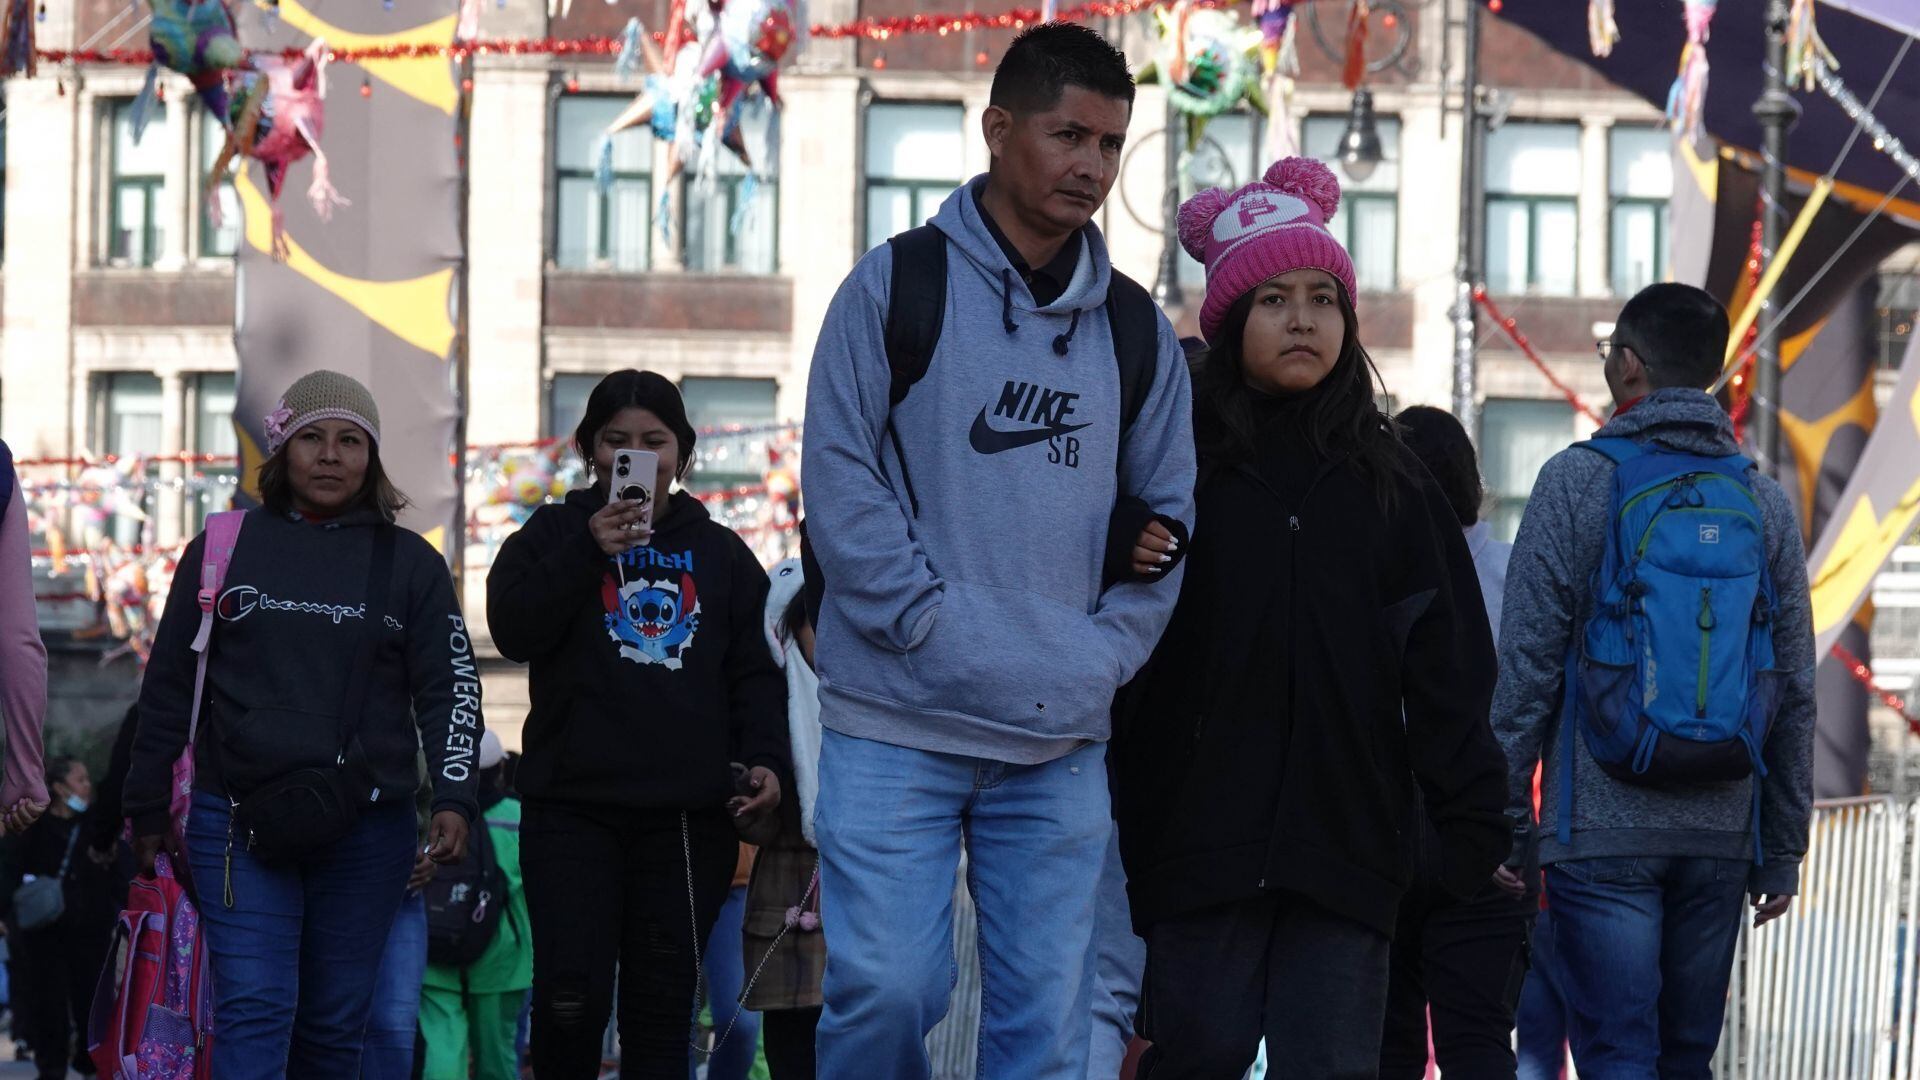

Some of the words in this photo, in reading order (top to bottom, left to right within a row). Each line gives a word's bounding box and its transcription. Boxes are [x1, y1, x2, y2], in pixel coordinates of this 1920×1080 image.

[994, 381, 1080, 427] NIKE
[1047, 434, 1080, 468] SB
[217, 585, 403, 631] Champin
